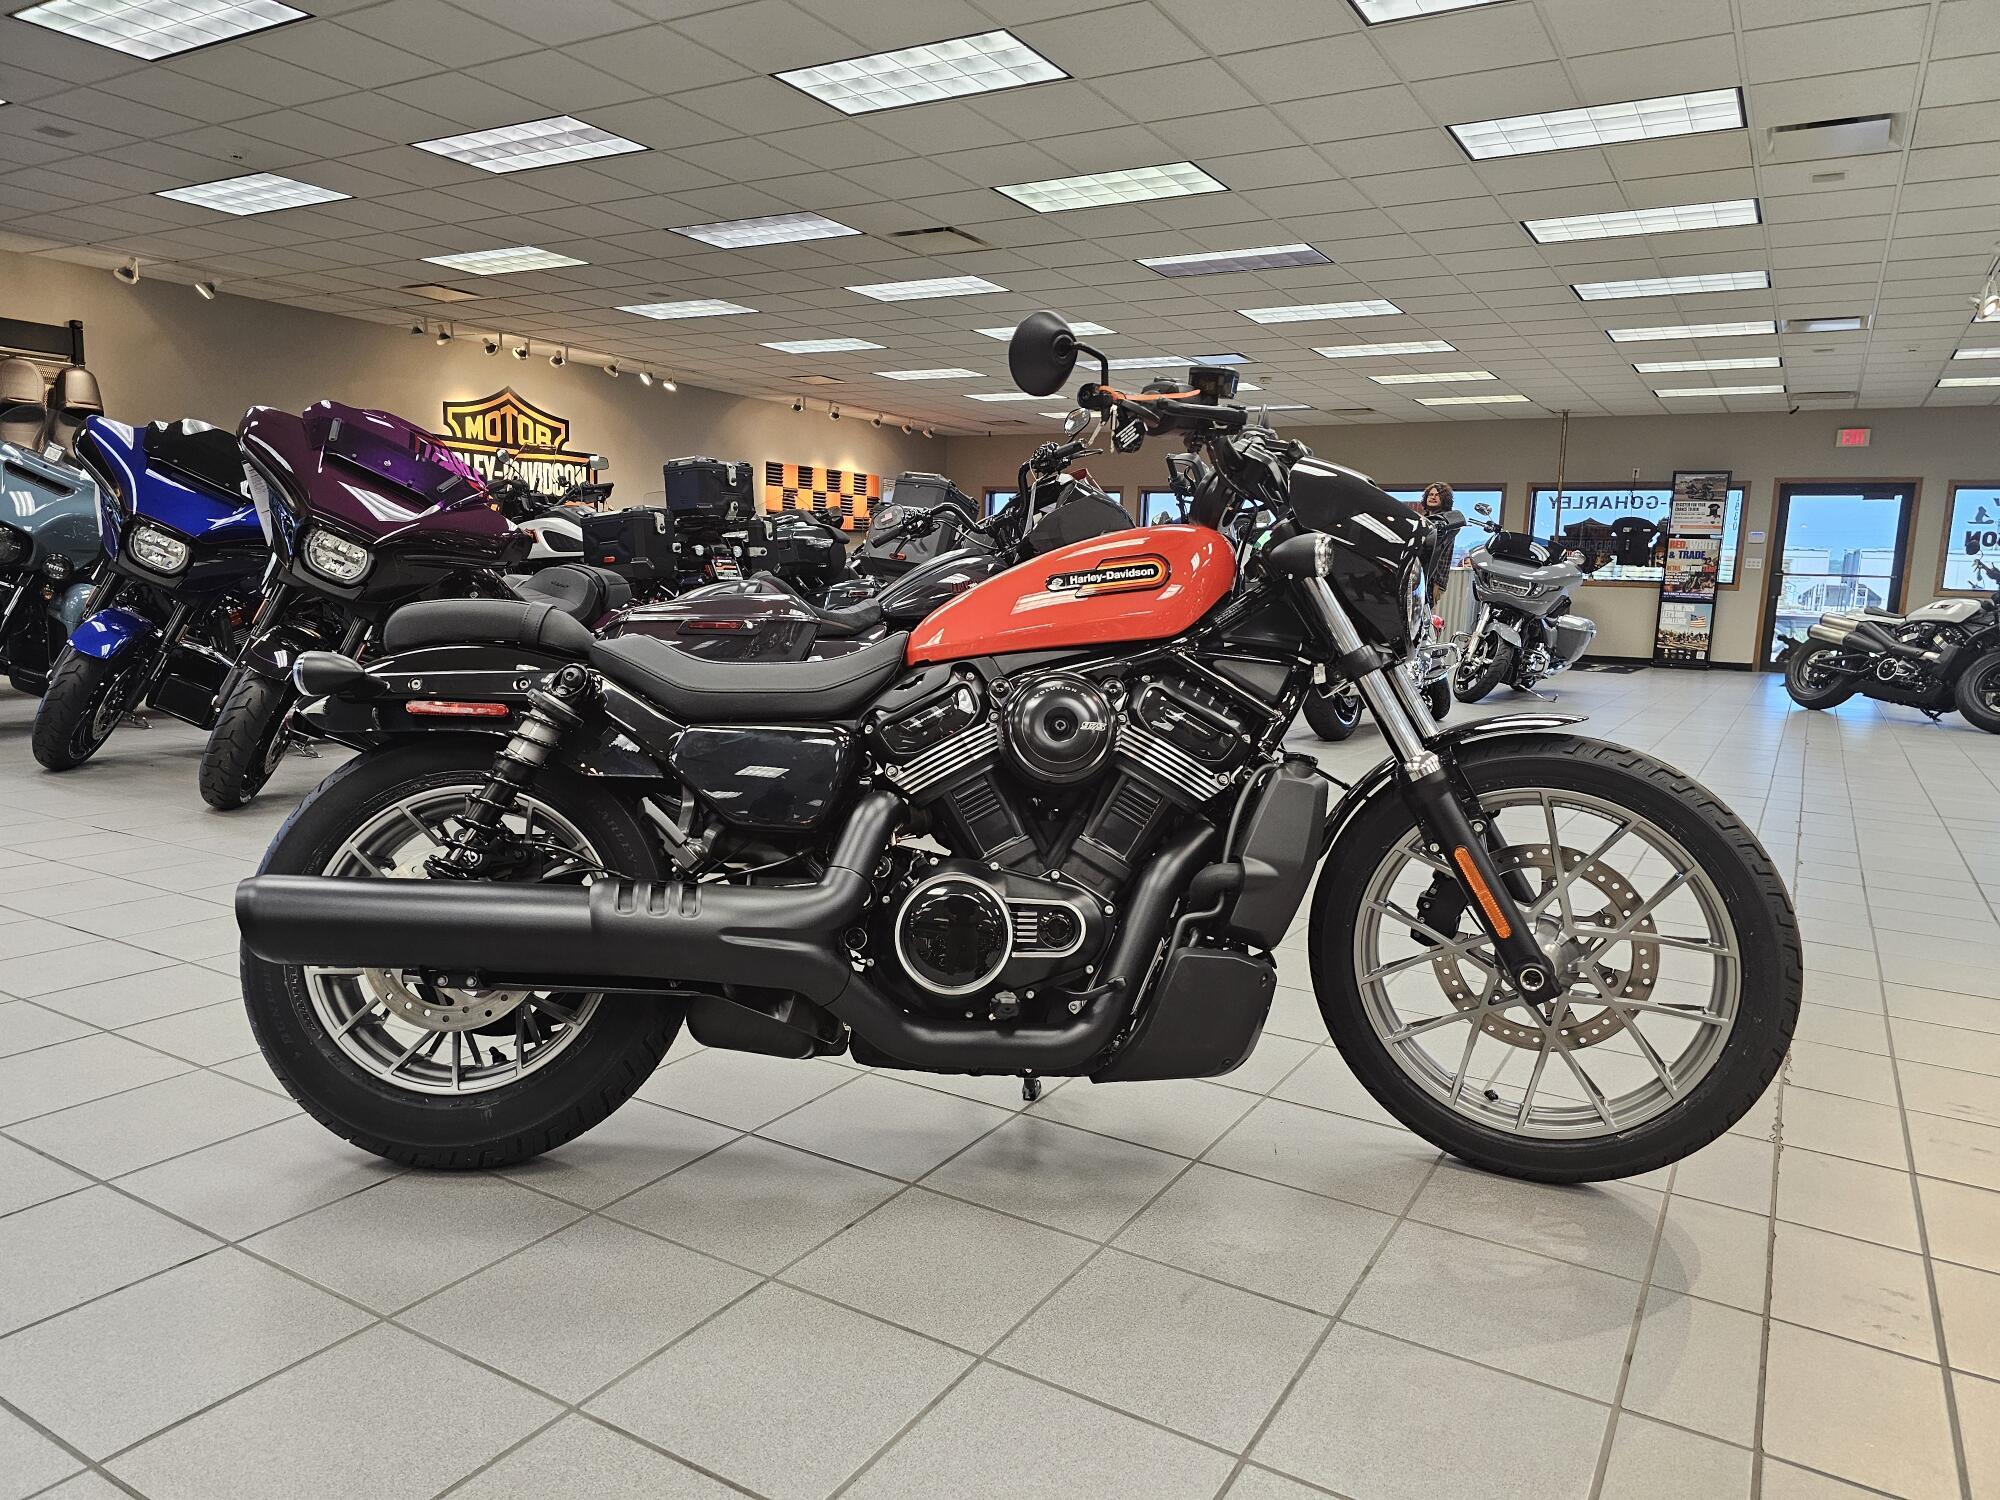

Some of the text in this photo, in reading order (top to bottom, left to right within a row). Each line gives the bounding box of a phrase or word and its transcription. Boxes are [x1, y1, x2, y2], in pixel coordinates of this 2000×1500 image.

[465, 404, 552, 446] MOTOR
[1842, 431, 1865, 445] EXIT
[1669, 540, 1718, 551] RED, WHITE
[1668, 550, 1706, 560] & TRADE
[1069, 567, 1155, 585] Harley-Davidson
